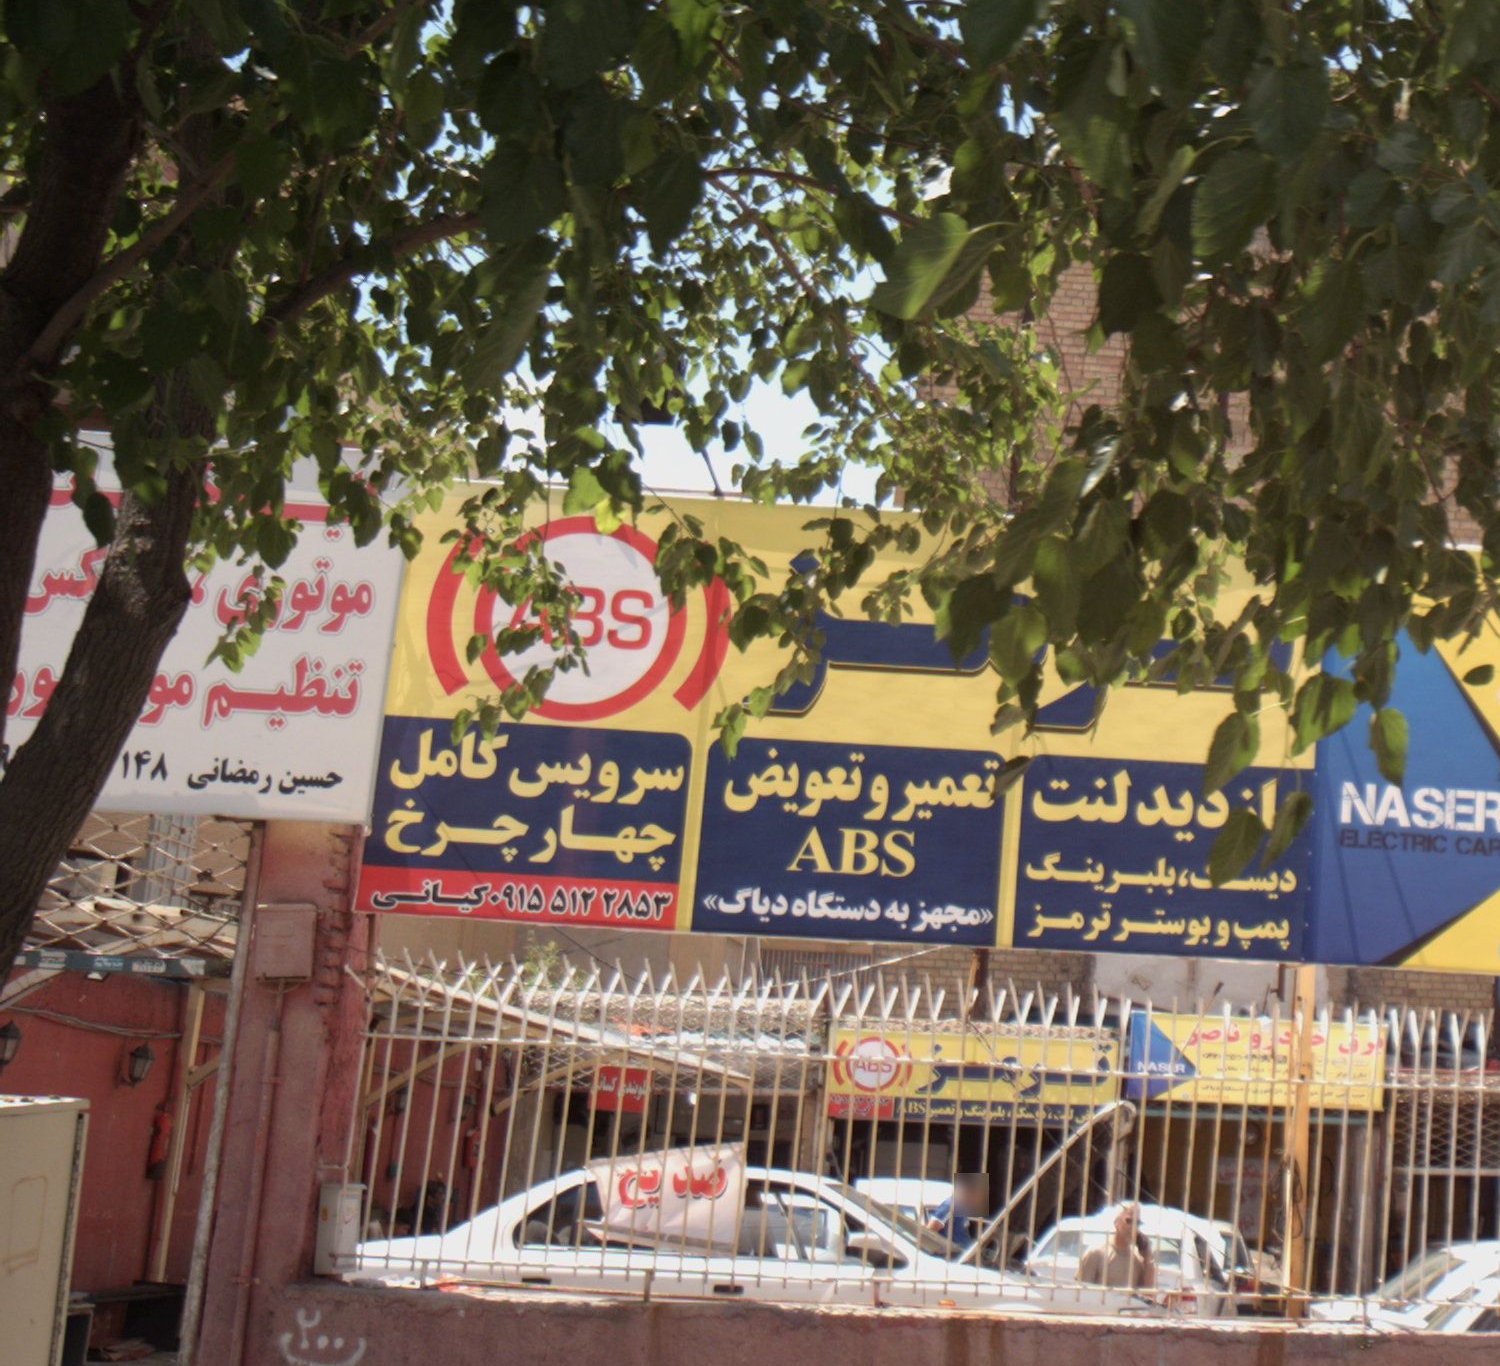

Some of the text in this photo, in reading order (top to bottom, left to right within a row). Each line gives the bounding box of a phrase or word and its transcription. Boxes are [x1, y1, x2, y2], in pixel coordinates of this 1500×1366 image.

[203, 656, 362, 728] تنظیم
[187, 757, 271, 793] رمضانی
[278, 771, 343, 793] حسین
[389, 729, 685, 805] سرویس کامل
[723, 747, 1000, 822] تعمیر و تعویض
[1032, 768, 1133, 827] لنت
[384, 799, 677, 873] چهار چرخ
[786, 825, 916, 877] ABS
[1339, 828, 1448, 855] ELECTRIC
[1025, 852, 1177, 896] بلبرینگ
[371, 879, 490, 914] کیانی
[792, 890, 880, 923] دستگاه
[884, 895, 908, 923] به
[1027, 901, 1291, 951] پمپ و بوستر ترمز
[1138, 1061, 1186, 1074] NASR
